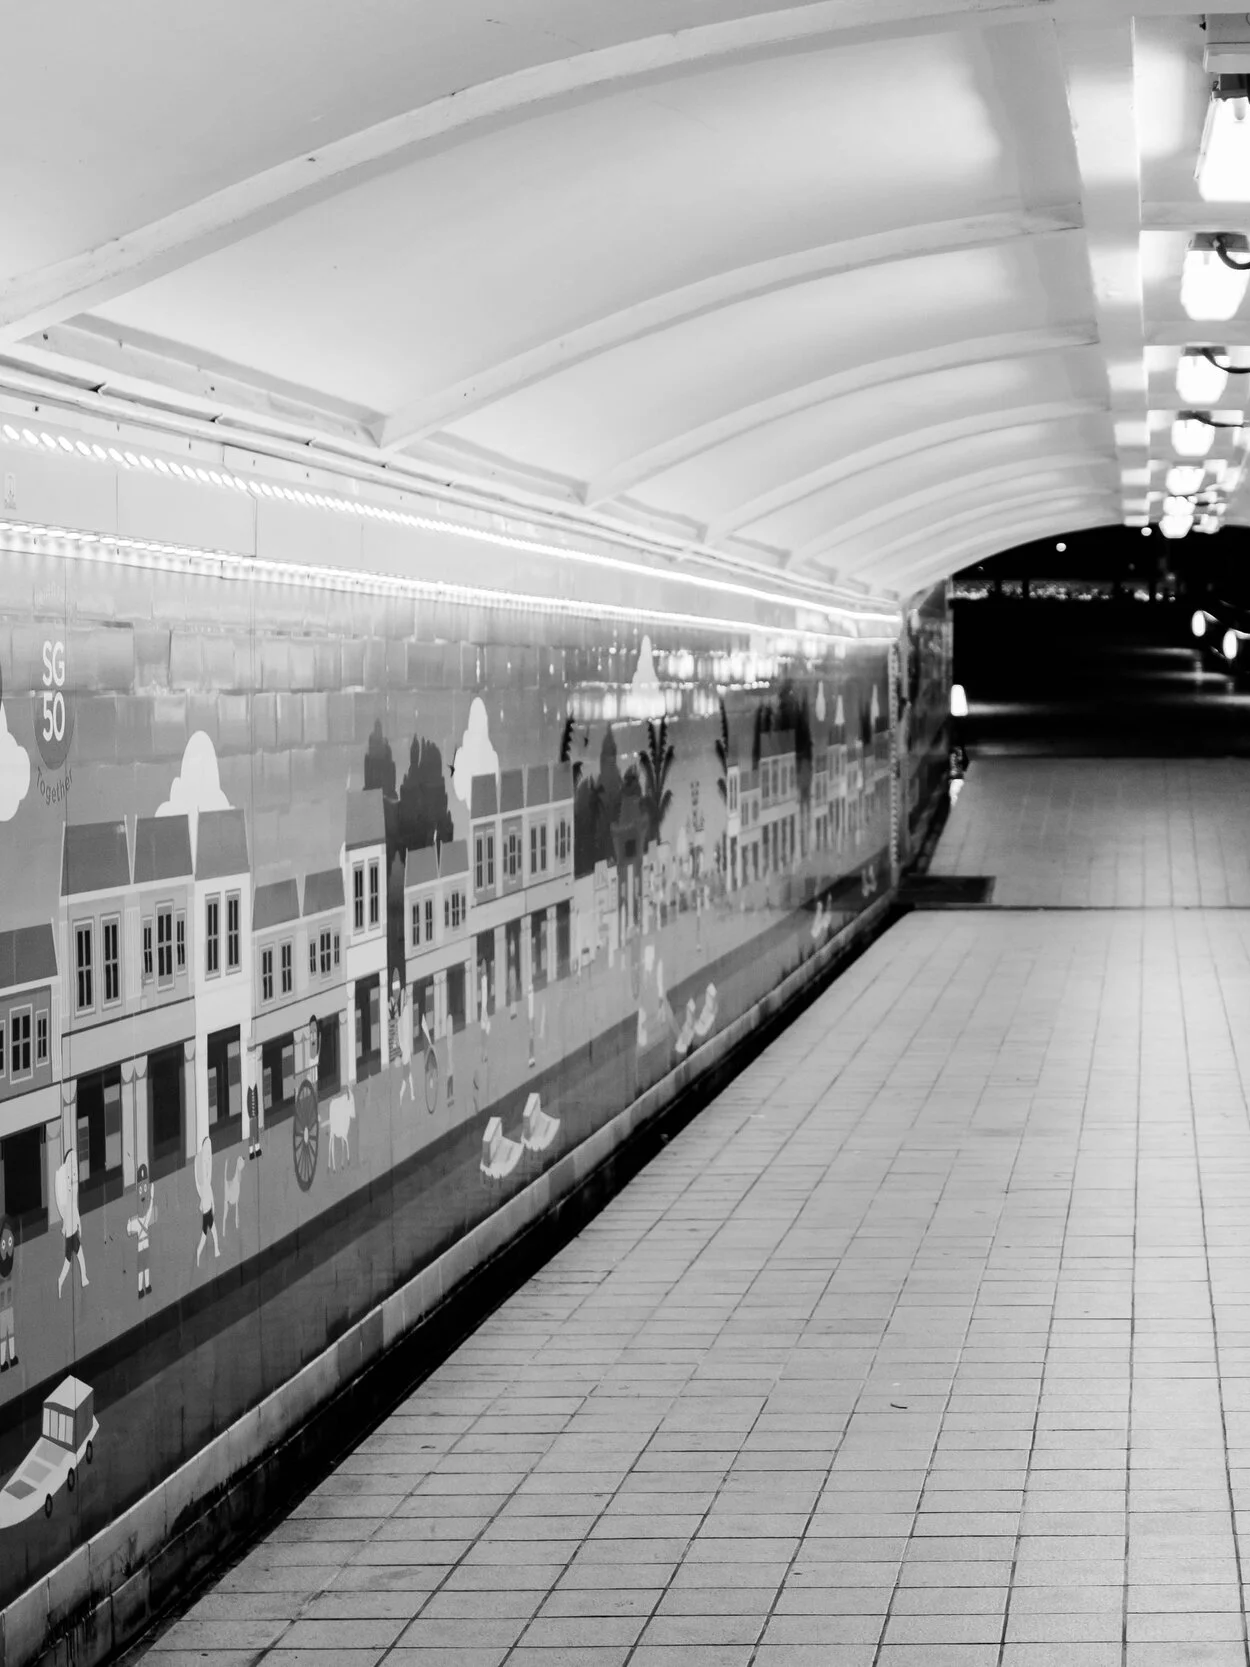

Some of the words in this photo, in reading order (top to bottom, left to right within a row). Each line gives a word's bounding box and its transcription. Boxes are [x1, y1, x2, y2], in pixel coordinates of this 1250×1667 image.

[42, 640, 65, 686] SG
[43, 692, 66, 742] 50
[36, 765, 73, 806] Together
